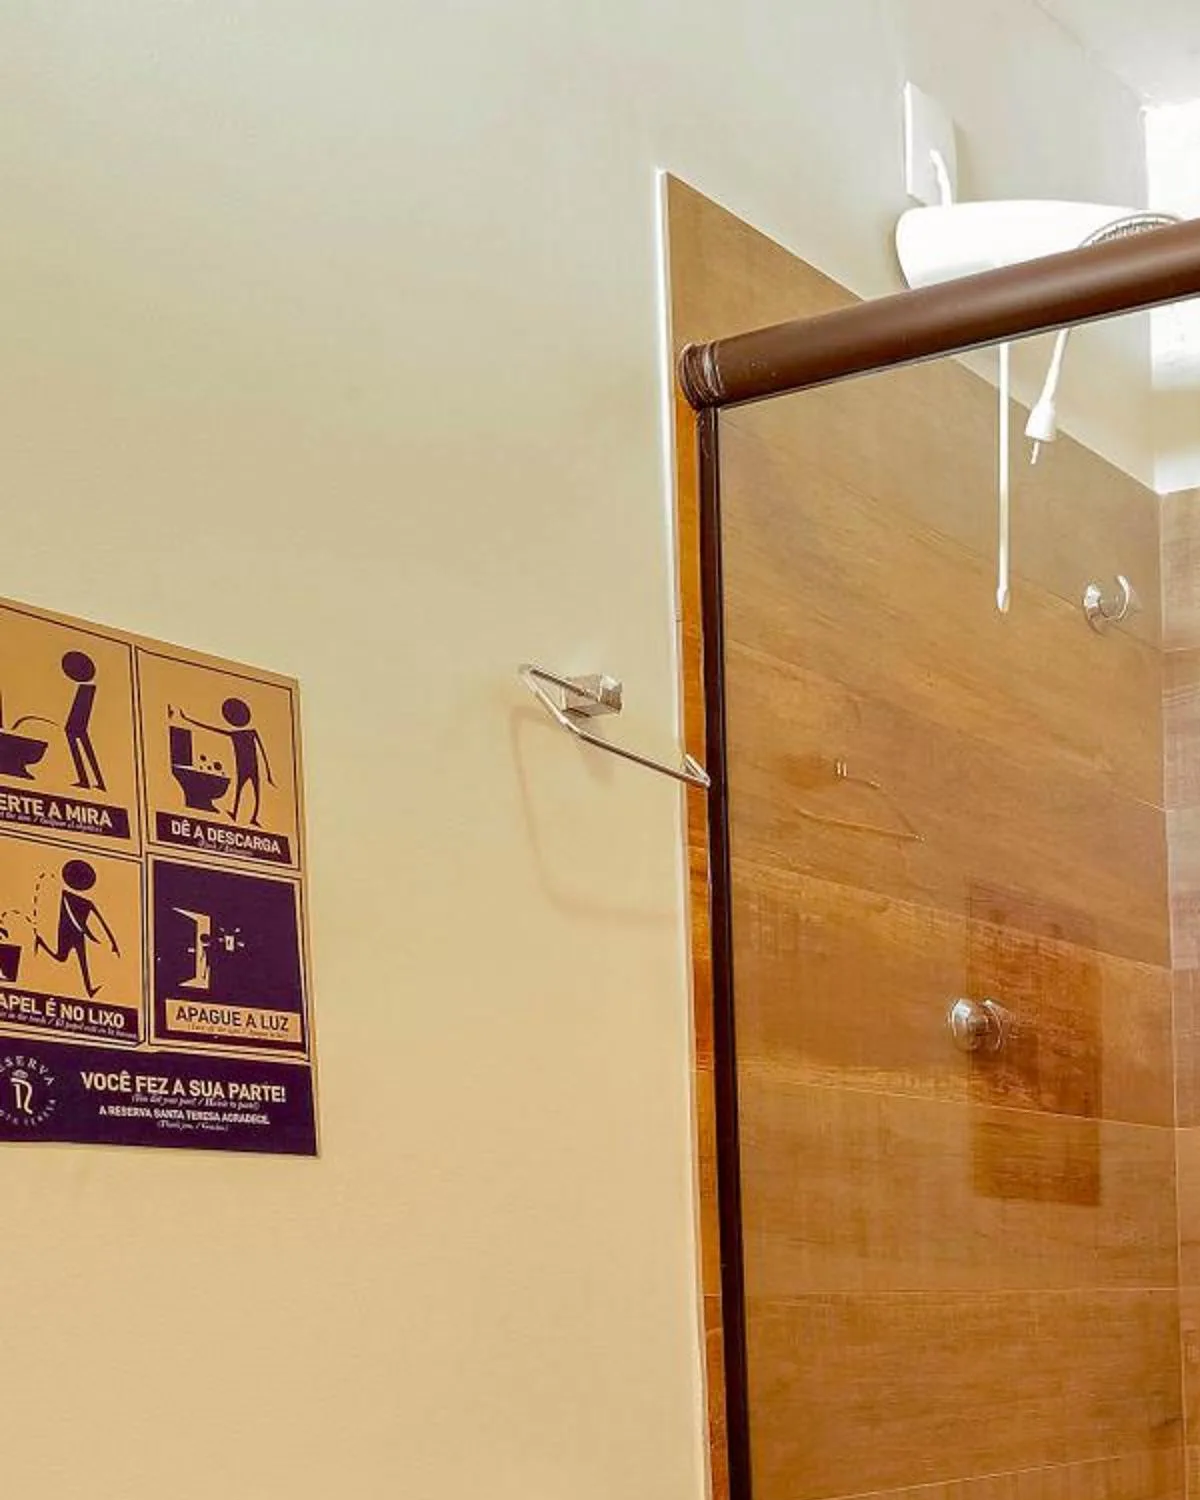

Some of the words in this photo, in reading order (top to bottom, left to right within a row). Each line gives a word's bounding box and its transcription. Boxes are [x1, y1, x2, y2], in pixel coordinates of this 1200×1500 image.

[48, 801, 61, 819] A
[65, 803, 112, 828] MIRA
[171, 820, 191, 837] DÊ
[193, 825, 204, 839] A
[207, 827, 281, 854] DESCARGA
[45, 997, 56, 1017] É
[61, 1003, 84, 1021] NO
[88, 1008, 125, 1029] LIXO
[176, 1005, 242, 1026] APAGUE
[245, 1013, 257, 1029] A
[260, 1013, 289, 1032] LUZ
[80, 1069, 132, 1092] VOCÊ
[136, 1075, 169, 1095] FEZ
[172, 1078, 186, 1096] A
[189, 1079, 225, 1098] SUA
[228, 1082, 286, 1103] PARTE!
[98, 1105, 107, 1116] A
[108, 1105, 152, 1118] RESERVA
[153, 1107, 185, 1119] SANTA
[186, 1110, 220, 1122] TERESA
